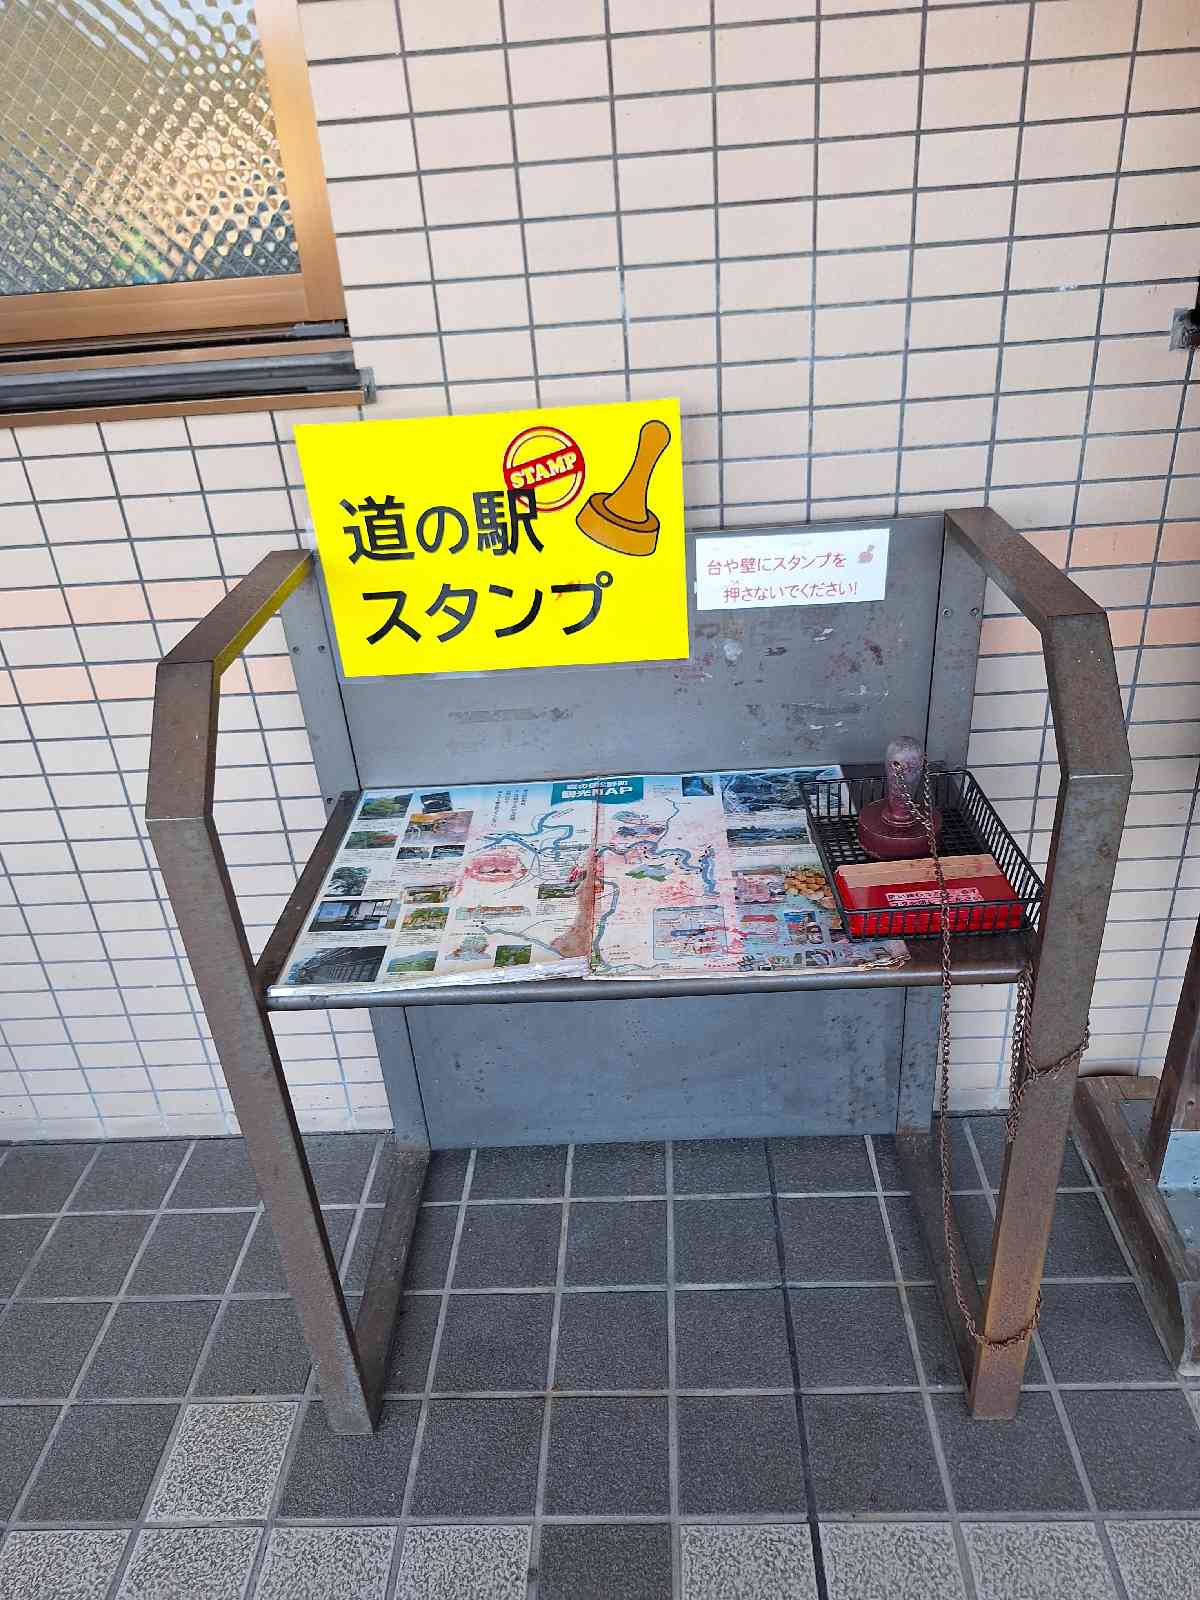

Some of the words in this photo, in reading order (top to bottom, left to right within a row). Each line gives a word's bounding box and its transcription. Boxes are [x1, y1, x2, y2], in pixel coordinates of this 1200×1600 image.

[509, 451, 578, 489] STAMP
[339, 487, 544, 565] 道の駅
[707, 552, 846, 576] 台や壁にスタンプを
[362, 570, 614, 645] スタンプ
